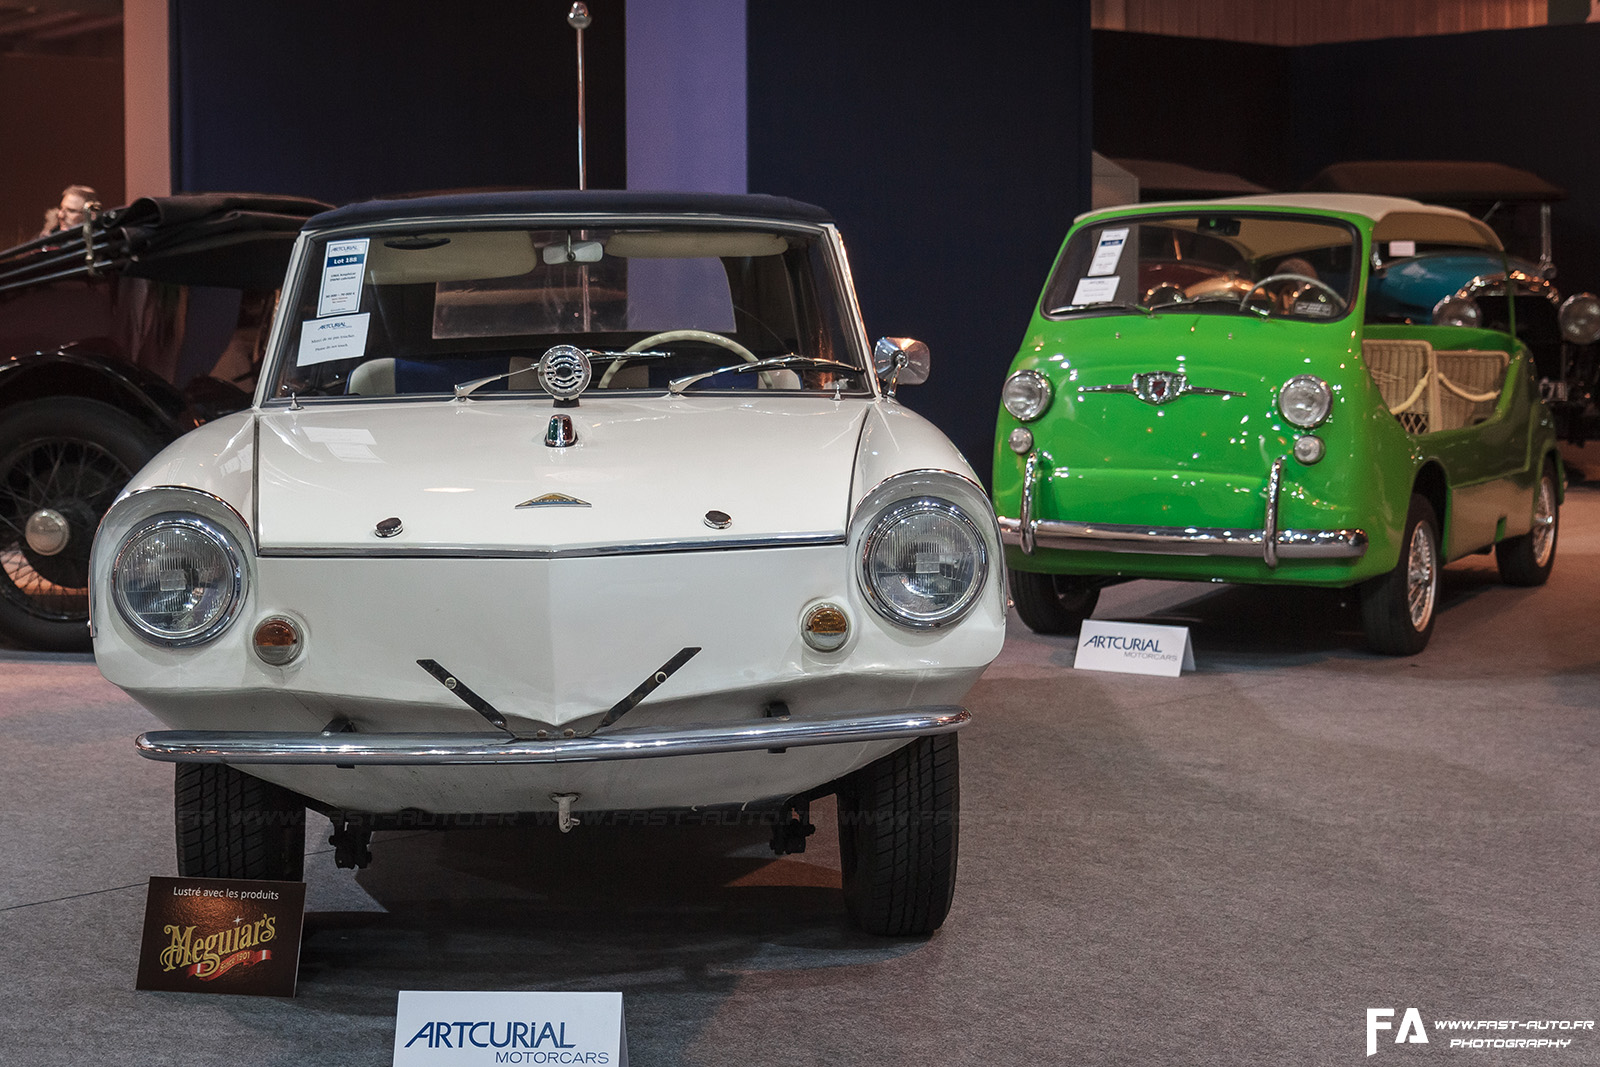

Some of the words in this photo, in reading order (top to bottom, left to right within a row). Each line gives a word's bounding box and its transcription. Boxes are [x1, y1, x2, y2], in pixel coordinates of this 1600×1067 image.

[1124, 651, 1178, 662] MOTORCARS
[173, 886, 201, 897] Lustré
[203, 889, 224, 898] avec
[226, 888, 239, 899] les
[240, 890, 279, 900] produits
[160, 913, 276, 977] Meguiar's
[495, 1051, 610, 1064] MOTORCARS
